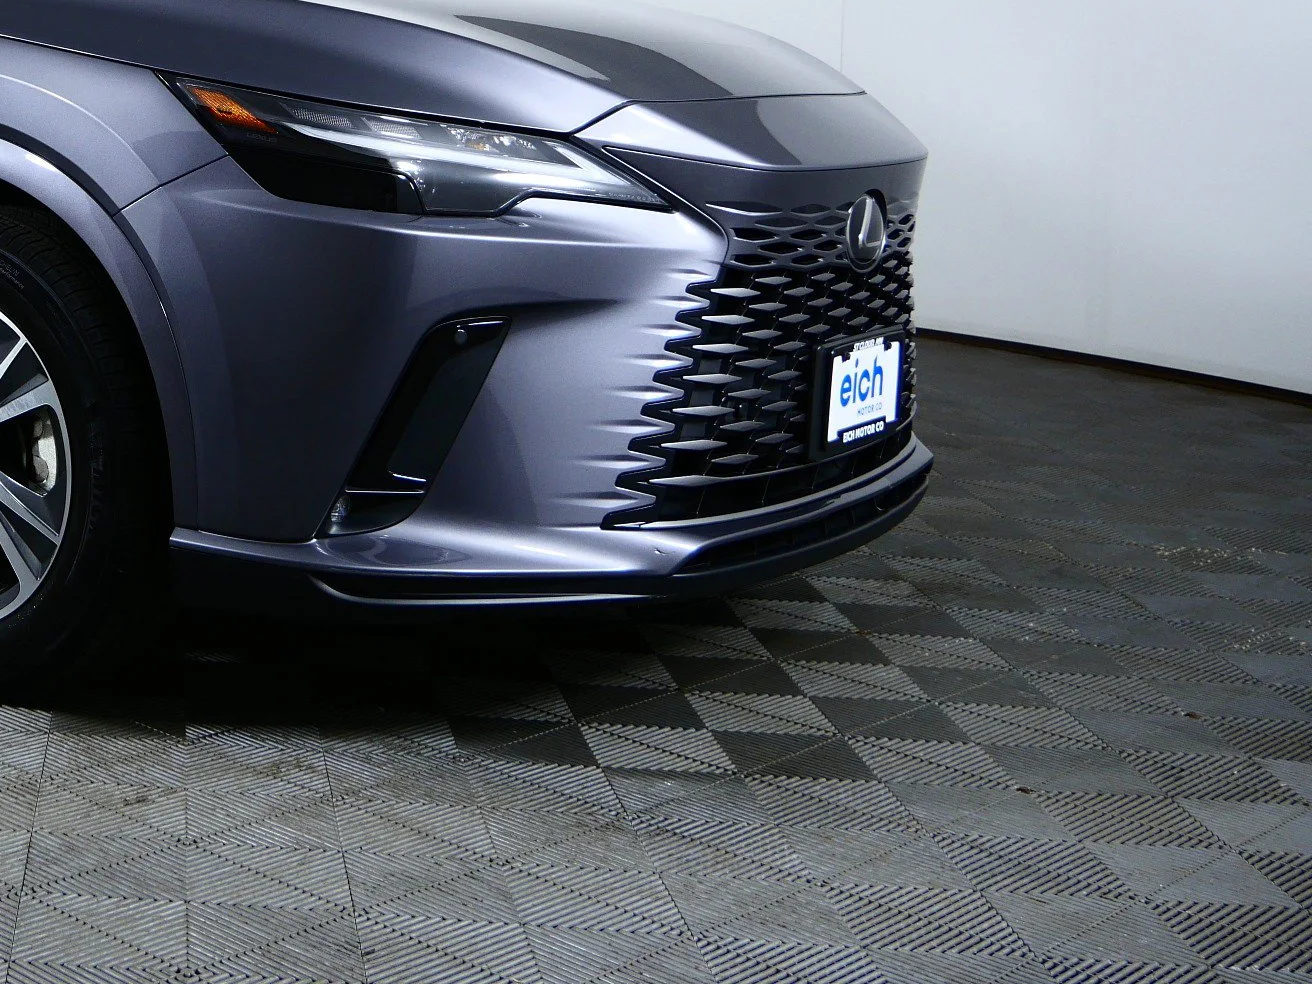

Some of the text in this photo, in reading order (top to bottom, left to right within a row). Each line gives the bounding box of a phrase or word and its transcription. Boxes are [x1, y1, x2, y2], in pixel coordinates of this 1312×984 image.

[840, 356, 884, 407] eich
[842, 421, 884, 443] EICH MOTOR CO
